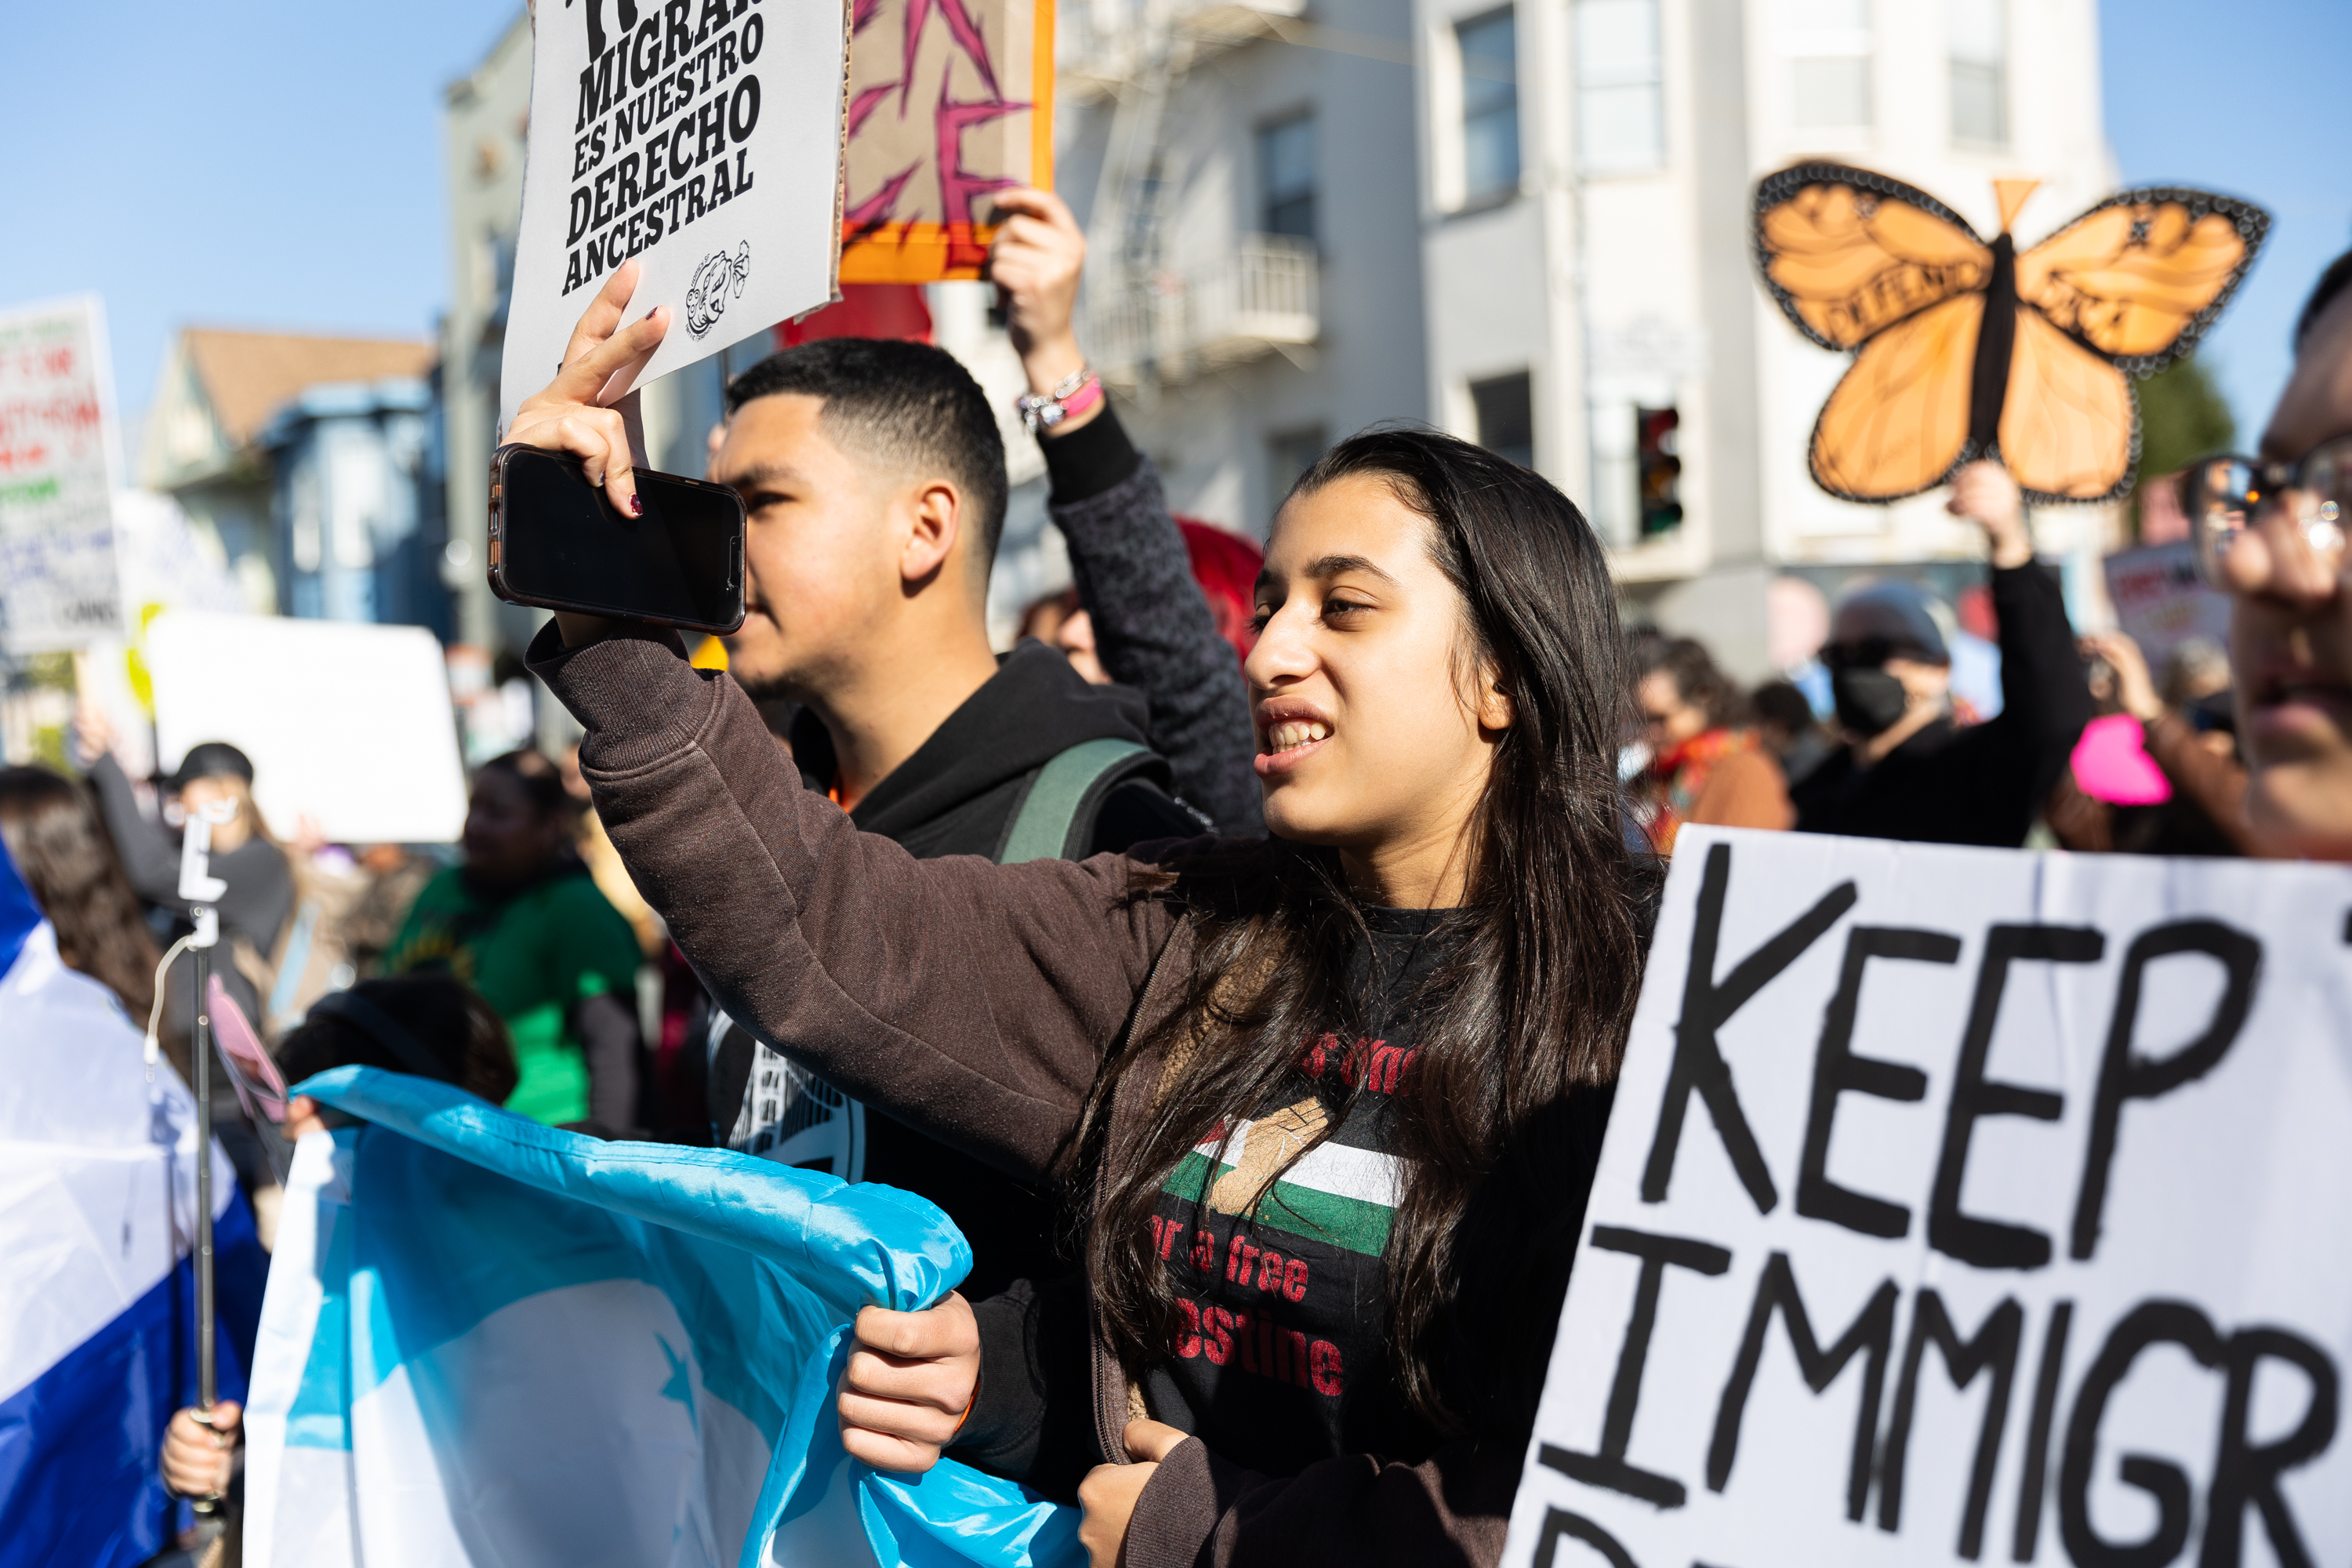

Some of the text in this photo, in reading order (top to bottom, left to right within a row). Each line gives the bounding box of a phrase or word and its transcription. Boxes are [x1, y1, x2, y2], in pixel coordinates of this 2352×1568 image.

[566, 74, 761, 249] DERECHO
[572, 120, 608, 183] ES
[612, 13, 764, 154] NUESTRO
[561, 147, 754, 297] ANCESTRAL
[1639, 842, 2264, 1270] KEEP
[1189, 1230, 1214, 1273] a
[1225, 1235, 1308, 1302] free
[1539, 1223, 2340, 1568] IMMIGR
